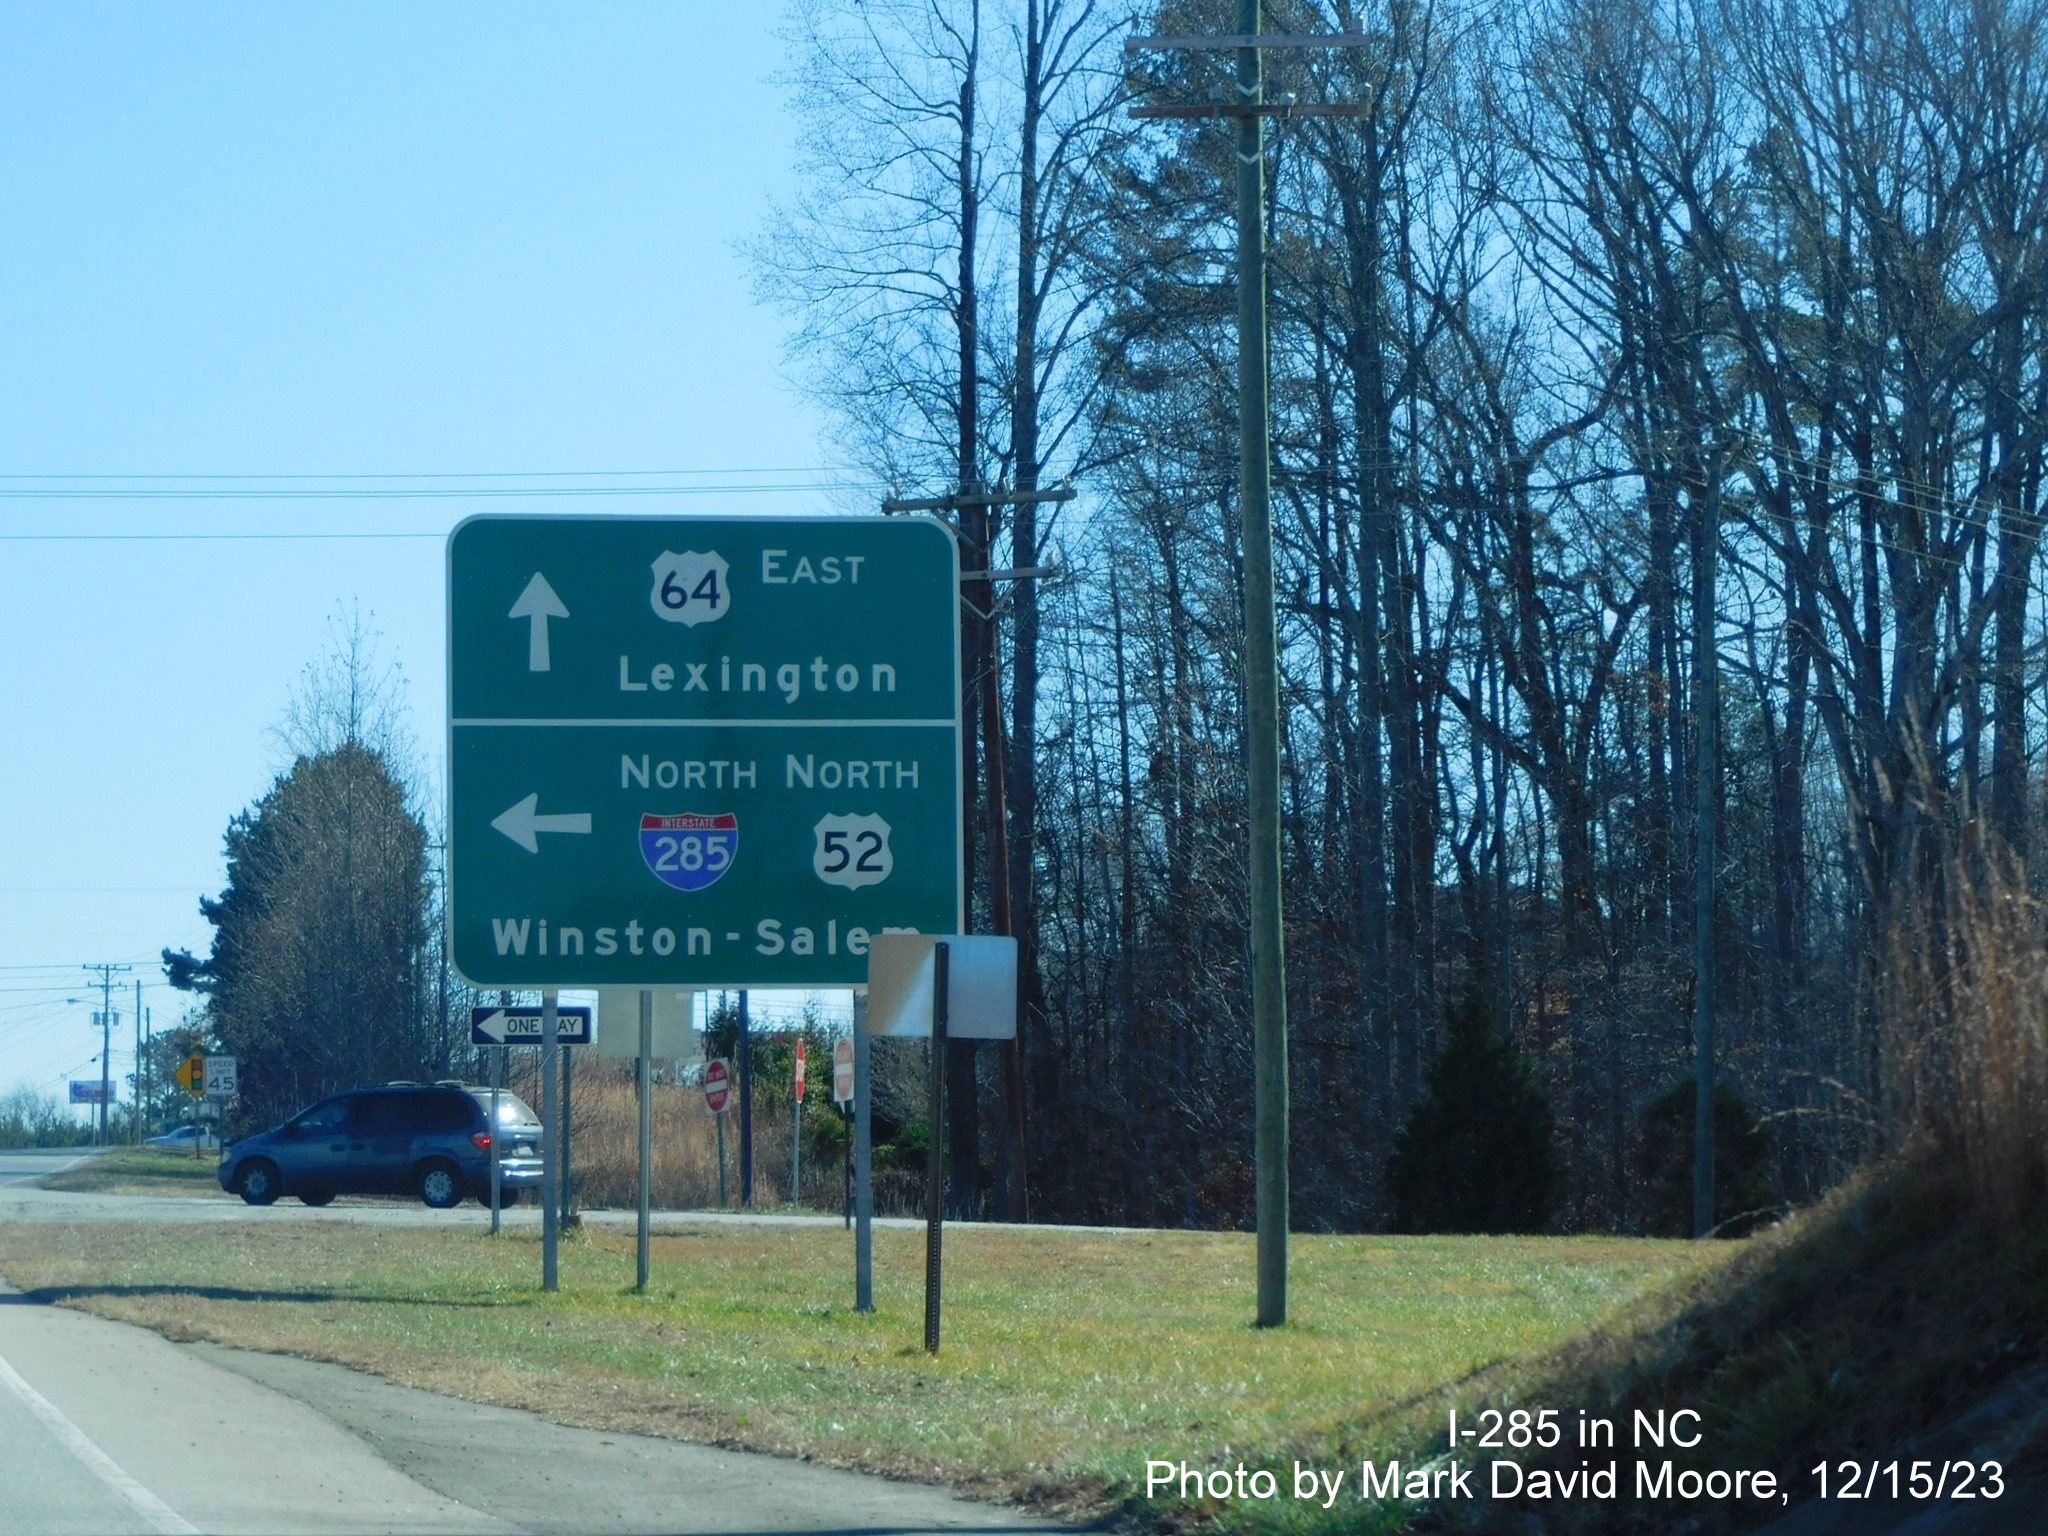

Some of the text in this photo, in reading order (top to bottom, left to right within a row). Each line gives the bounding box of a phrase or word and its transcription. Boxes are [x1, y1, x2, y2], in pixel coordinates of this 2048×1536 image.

[762, 549, 865, 585] EAST
[660, 568, 722, 610] 64
[619, 655, 898, 705] Lexington
[620, 754, 920, 790] NORTH NORTH
[660, 817, 717, 829] INTERSTATE
[654, 835, 730, 872] 285
[822, 830, 884, 873] 52
[492, 918, 922, 957] Winston-Sale
[506, 1018, 540, 1034] ONE
[556, 1018, 578, 1034] AY
[207, 1060, 234, 1068] SPEED
[210, 1068, 231, 1076] LIMIT
[208, 1076, 235, 1091] 45
